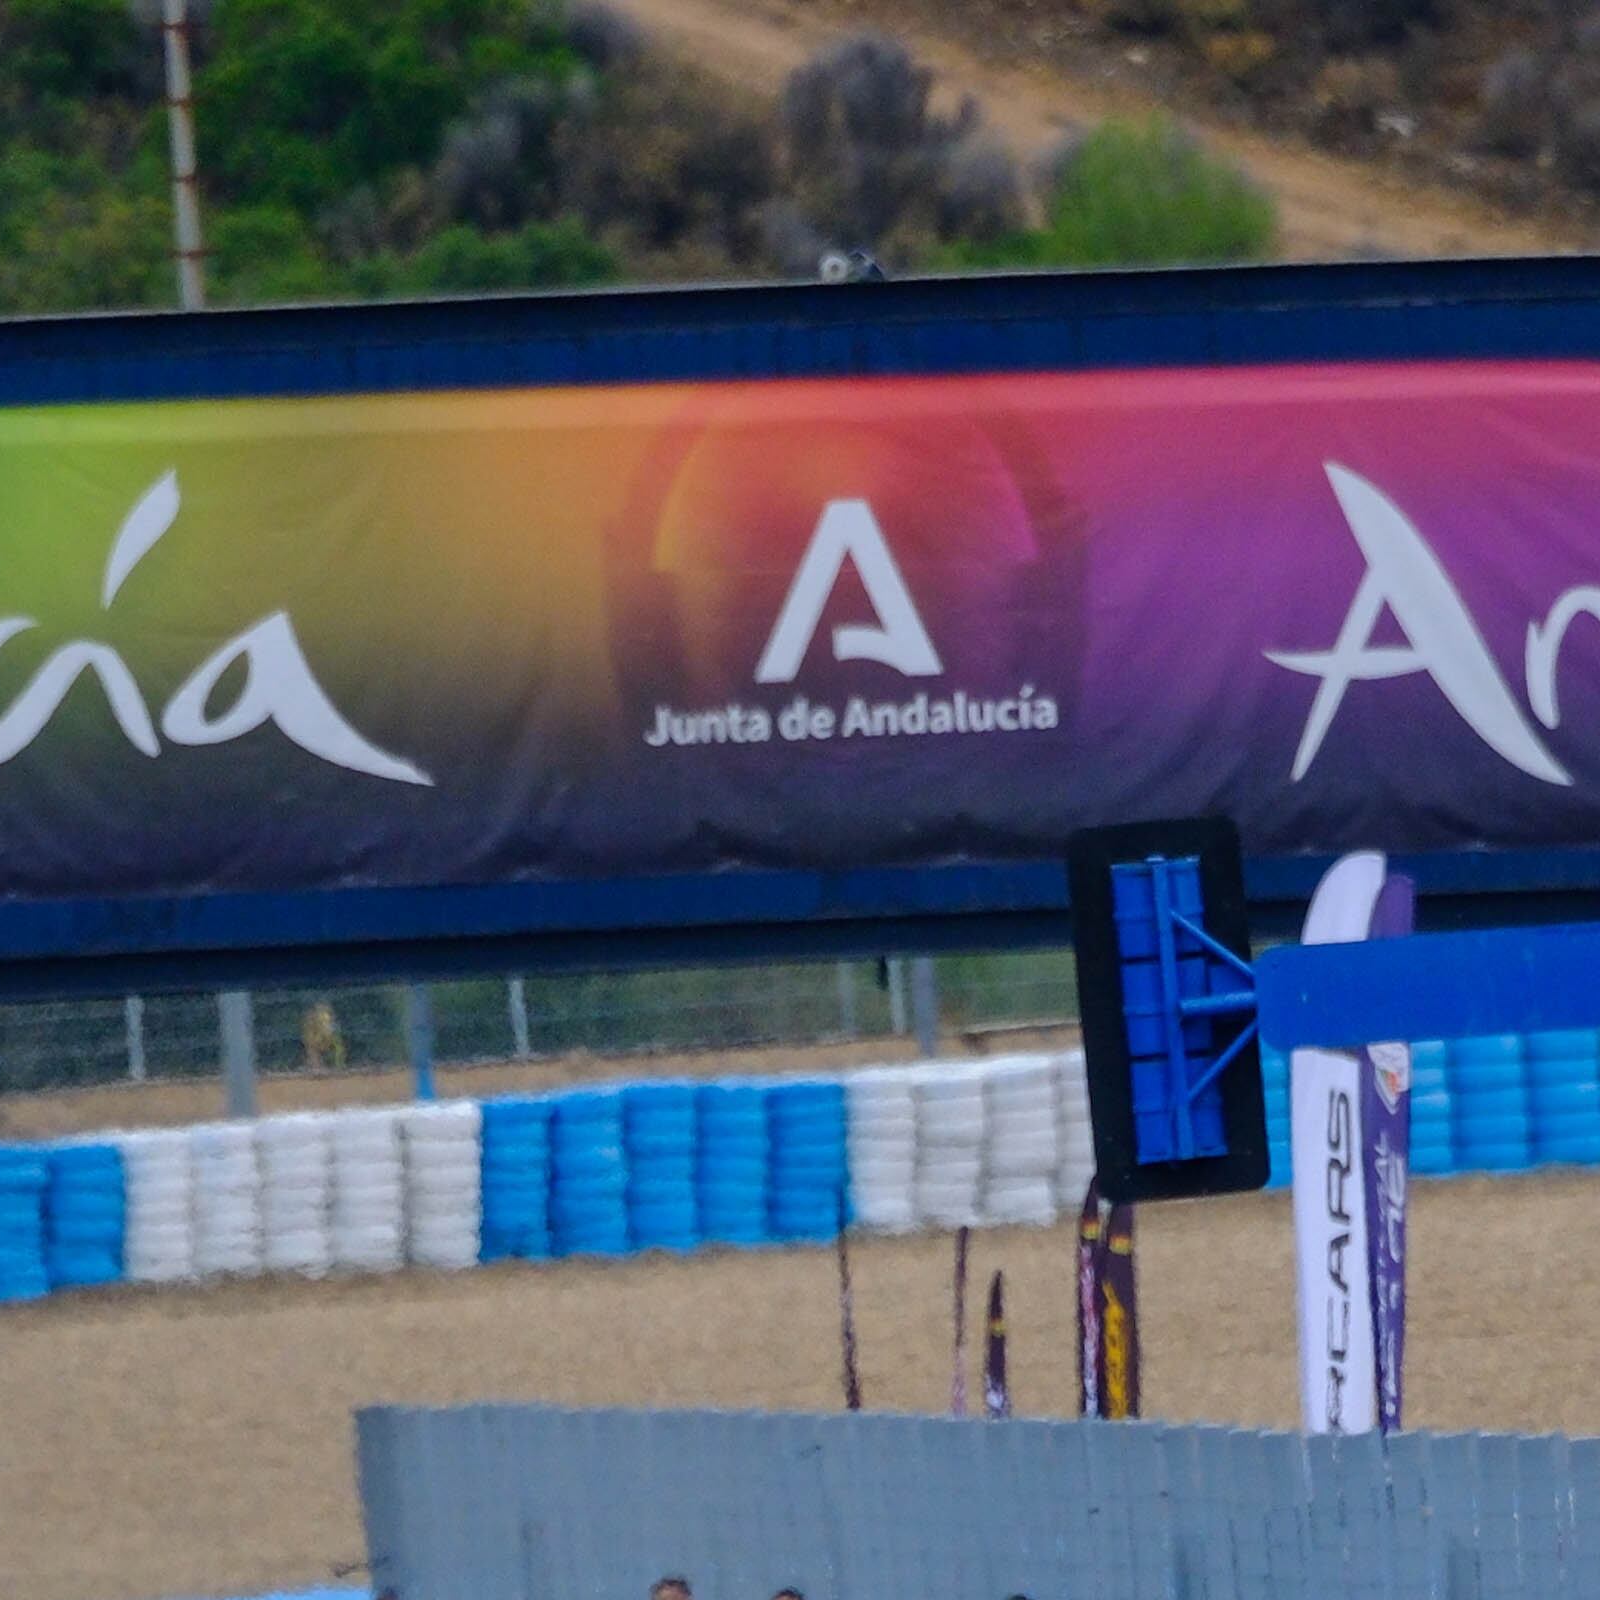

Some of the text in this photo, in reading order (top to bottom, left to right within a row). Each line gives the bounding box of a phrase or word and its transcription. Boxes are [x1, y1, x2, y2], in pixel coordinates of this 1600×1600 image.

[643, 683, 1060, 747] Junta de Andalucía
